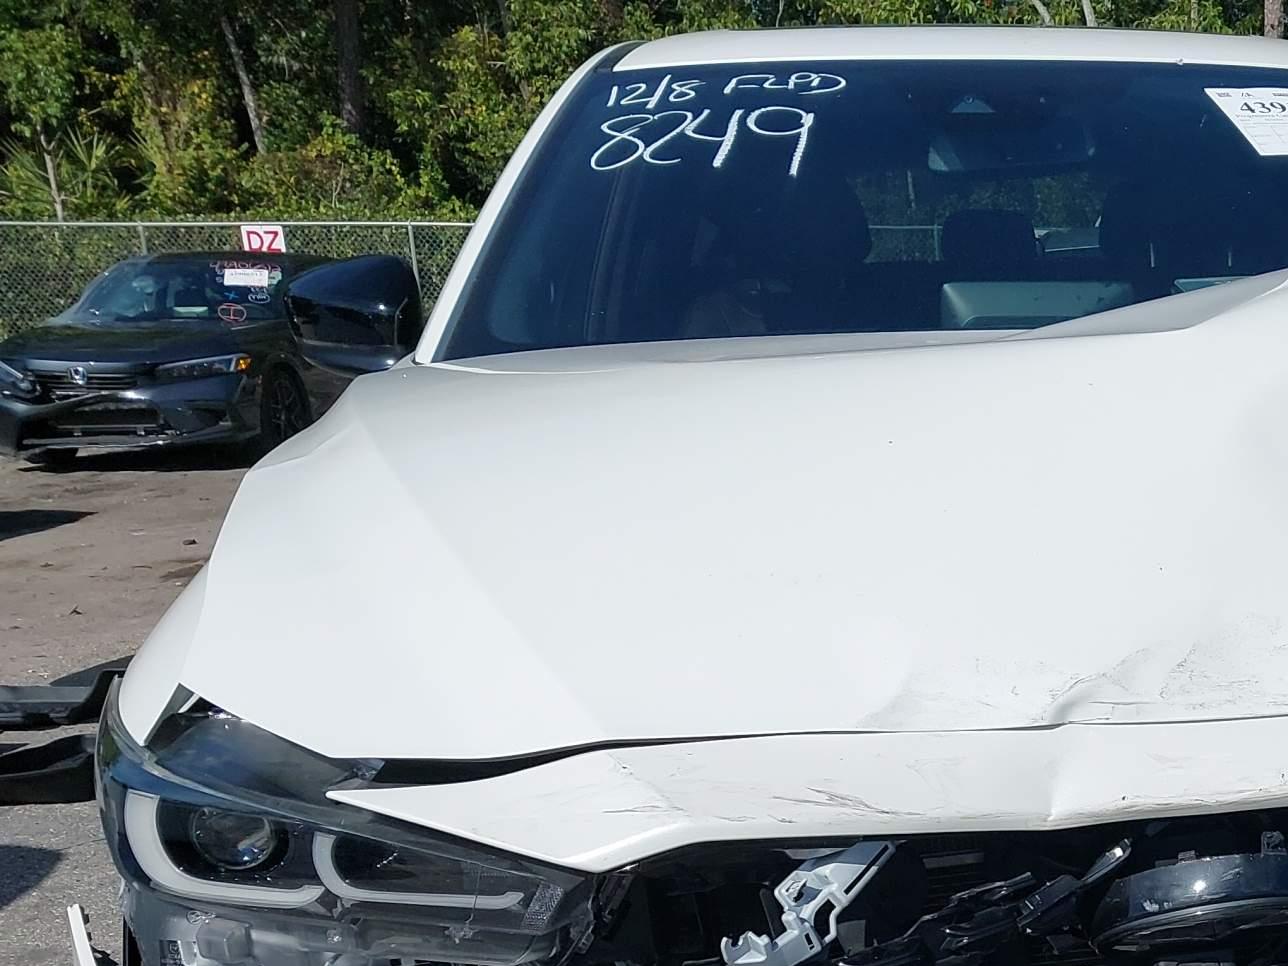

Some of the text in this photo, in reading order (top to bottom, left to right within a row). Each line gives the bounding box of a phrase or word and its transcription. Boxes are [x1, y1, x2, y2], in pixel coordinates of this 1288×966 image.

[606, 74, 706, 110] 12/8
[590, 106, 815, 178] 8249
[245, 230, 282, 253] DZ
